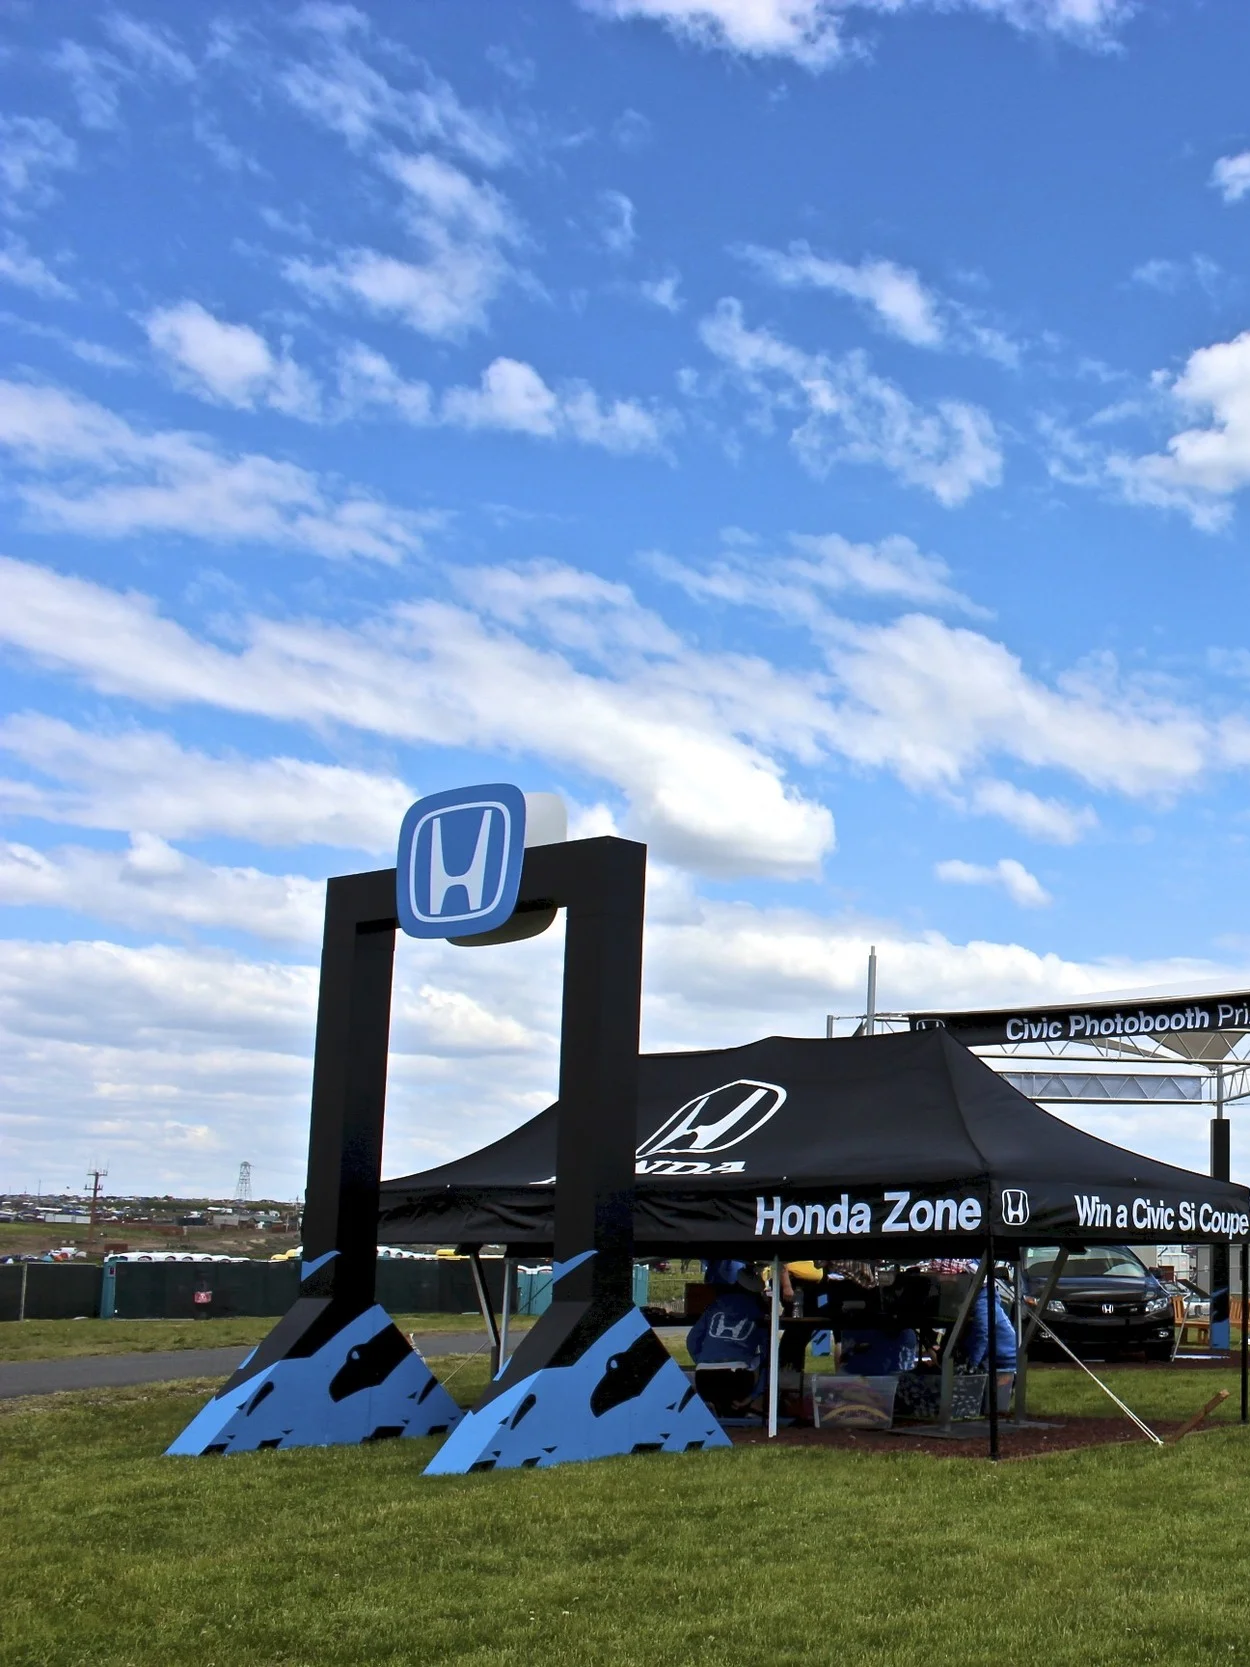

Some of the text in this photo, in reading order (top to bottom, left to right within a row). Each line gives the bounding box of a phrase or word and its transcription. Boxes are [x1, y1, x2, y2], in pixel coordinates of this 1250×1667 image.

[1006, 1016, 1062, 1041] Civic
[1069, 1006, 1210, 1037] Photobooth
[754, 1190, 982, 1236] Honda Zone
[1074, 1194, 1249, 1240] Win a Civic Si Coupe
